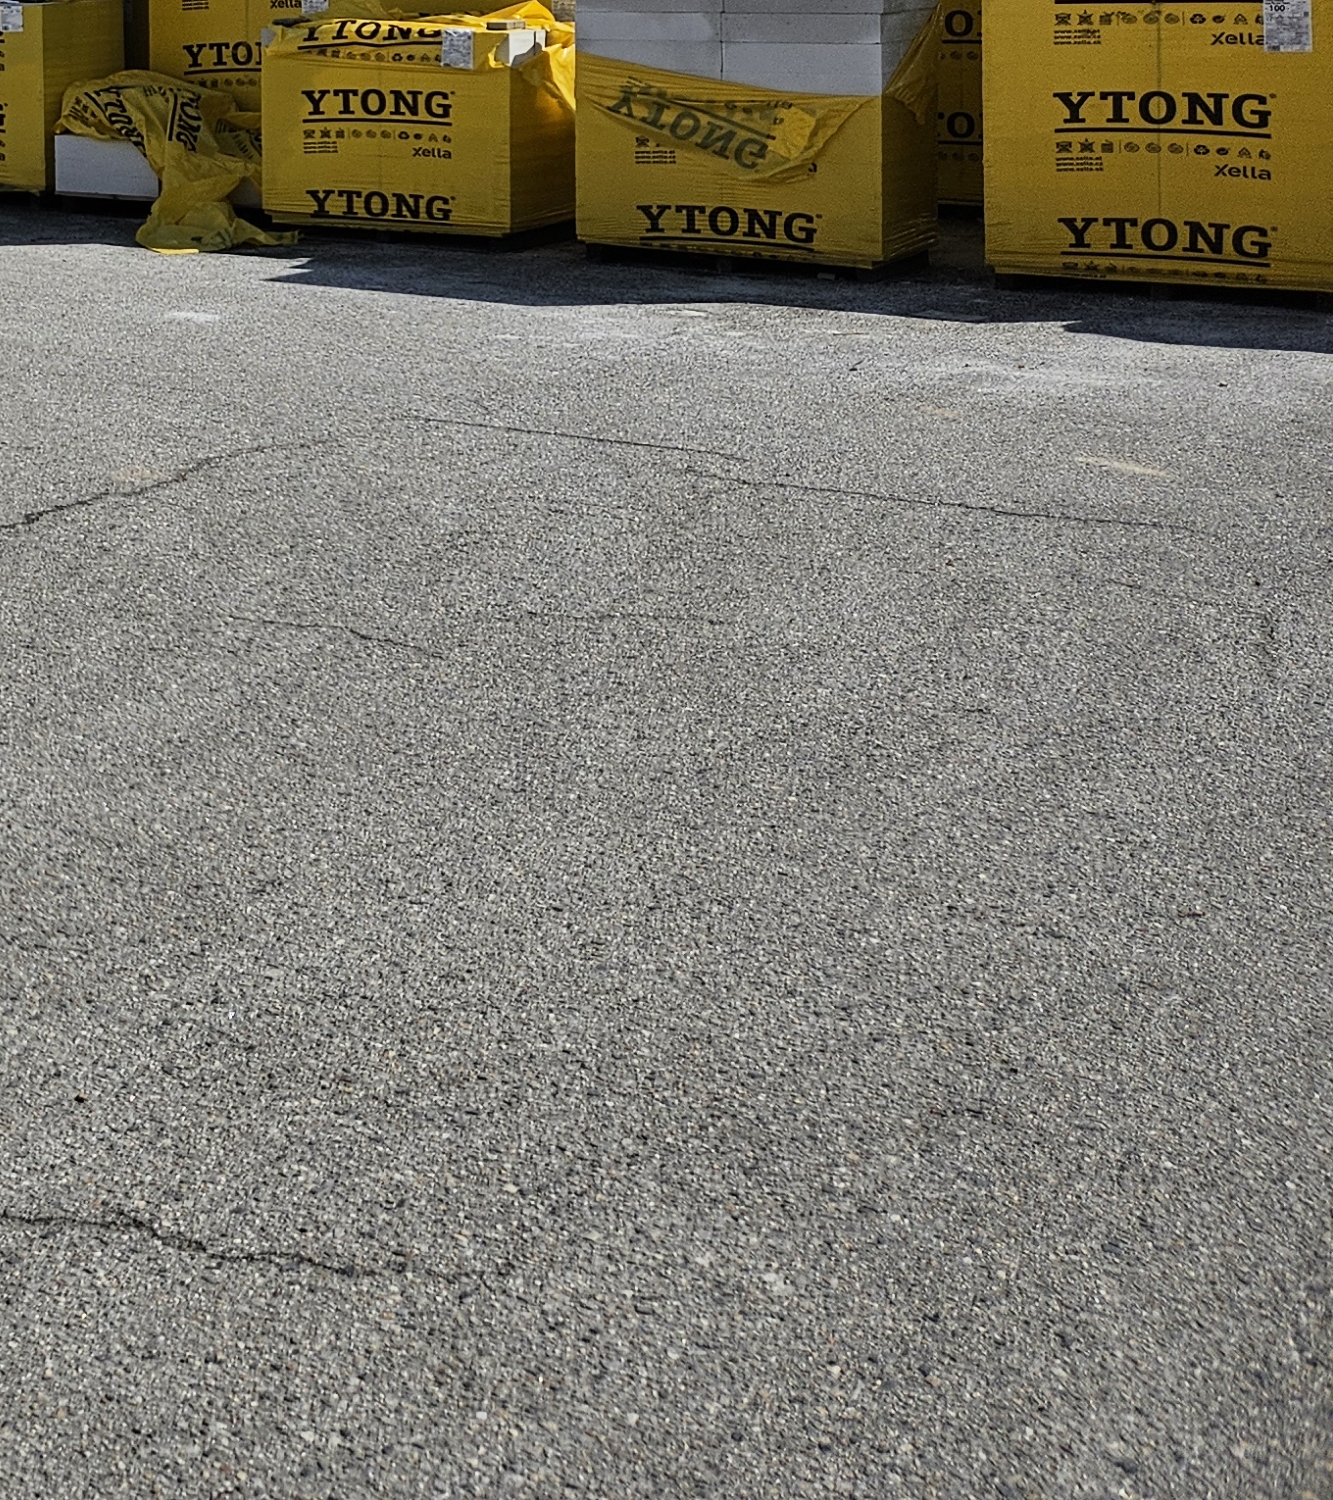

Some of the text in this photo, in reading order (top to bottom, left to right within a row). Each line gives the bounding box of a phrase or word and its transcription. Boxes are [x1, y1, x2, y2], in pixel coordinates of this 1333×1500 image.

[1268, 4, 1286, 12] 100
[301, 88, 453, 119] YTONG
[1052, 90, 1272, 129] YTONG
[305, 189, 453, 222] YTONG
[636, 204, 818, 244] YTONG
[1057, 217, 1273, 259] YTONG
